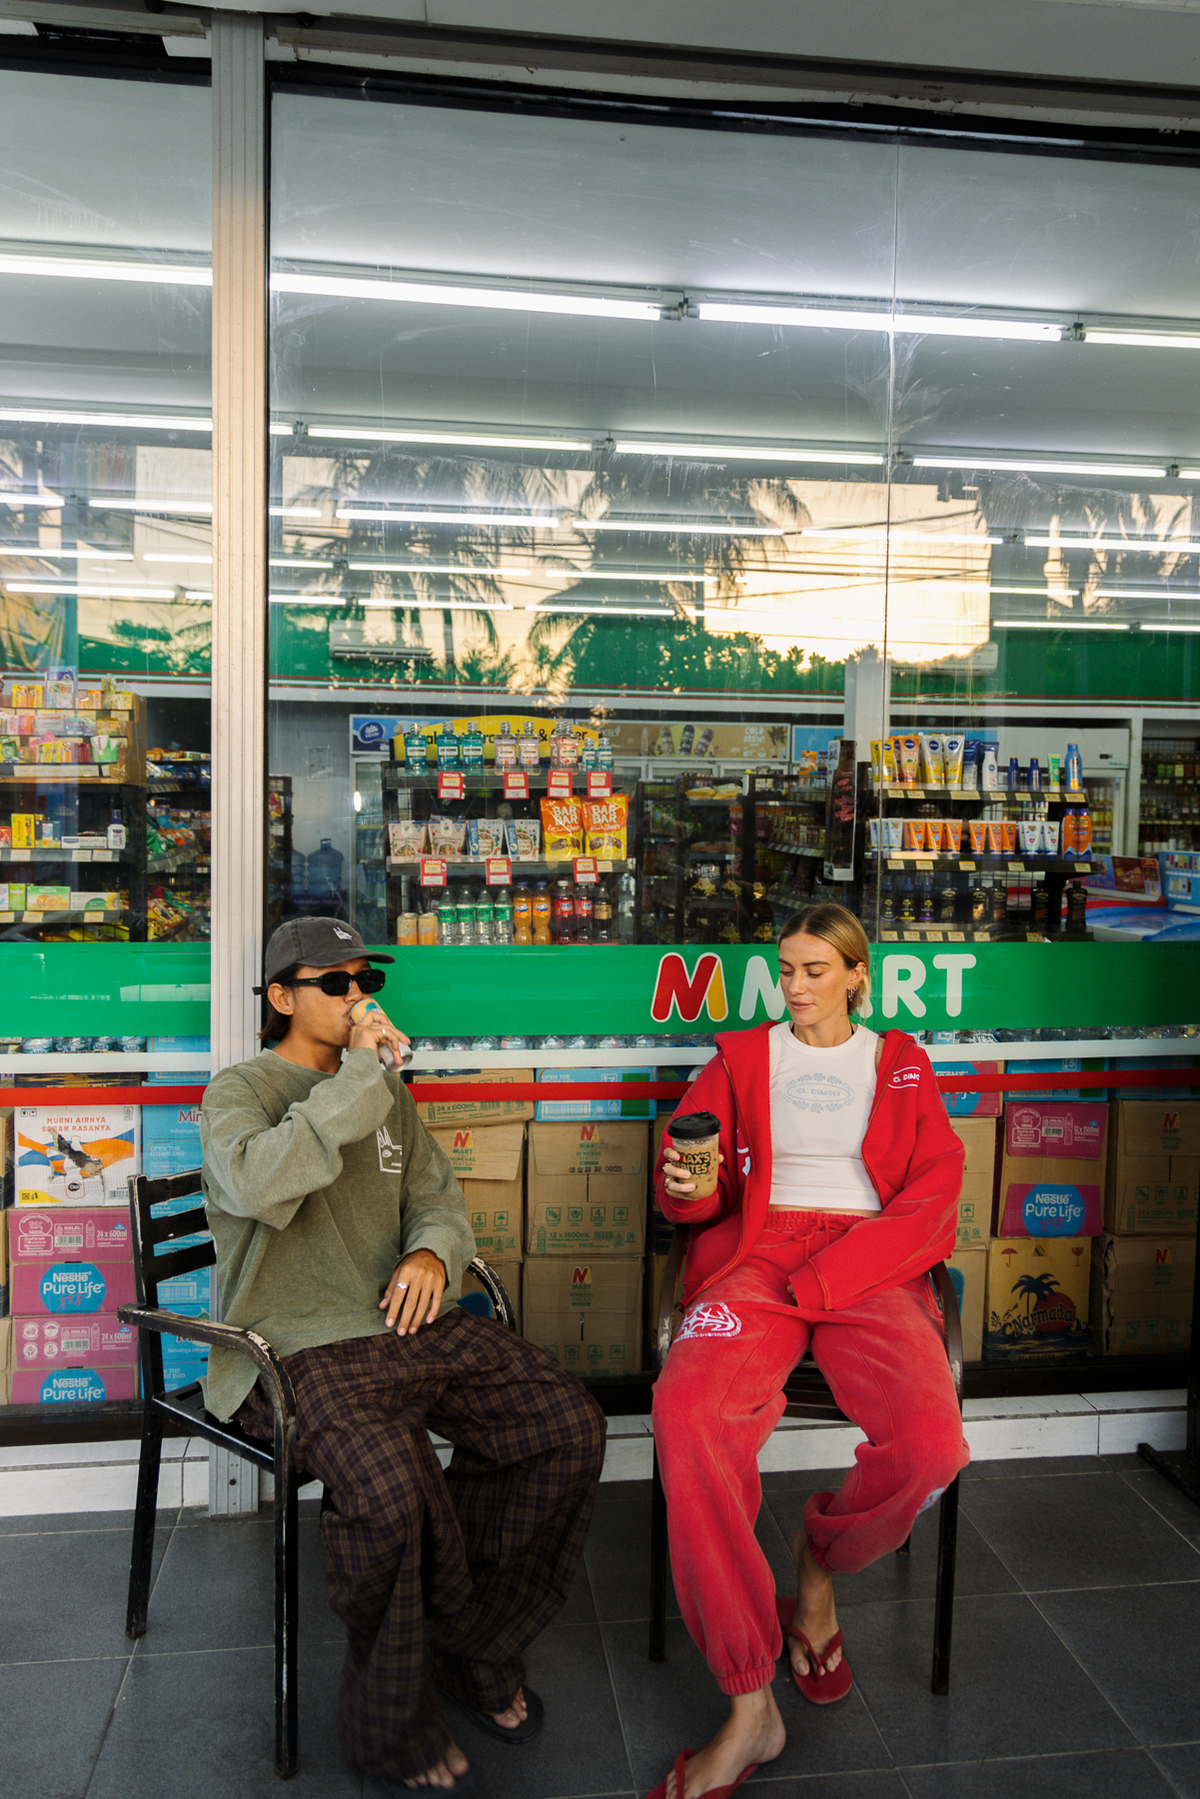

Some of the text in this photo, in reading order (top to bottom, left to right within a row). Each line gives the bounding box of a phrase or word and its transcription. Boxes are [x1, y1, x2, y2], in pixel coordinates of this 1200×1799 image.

[552, 806, 577, 816] BAR
[591, 804, 617, 815] BAR
[553, 815, 578, 826] BAR
[592, 814, 618, 824] BAR
[739, 954, 976, 1021] MRT
[1026, 1204, 1080, 1222] Pure Life
[43, 1281, 101, 1298] Pure Life
[1012, 1304, 1073, 1338] Narmada
[43, 1387, 101, 1401] Pure Life
